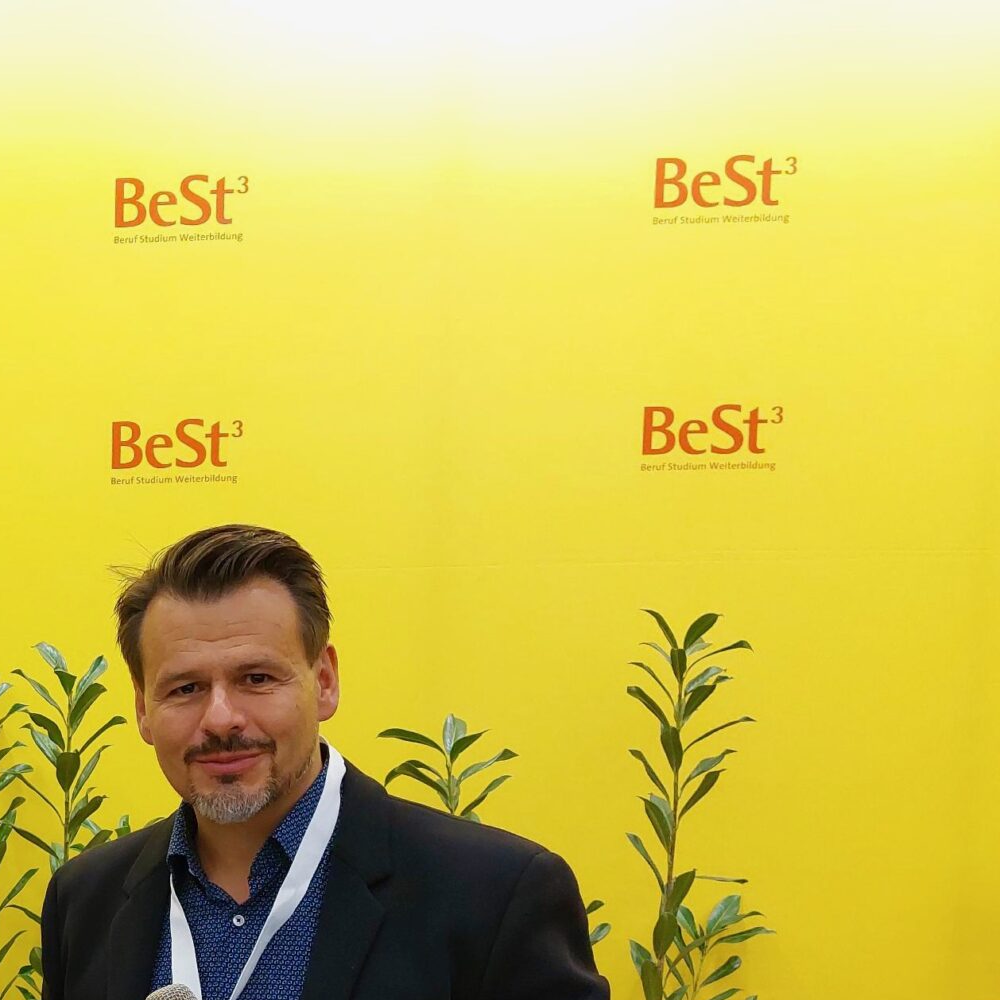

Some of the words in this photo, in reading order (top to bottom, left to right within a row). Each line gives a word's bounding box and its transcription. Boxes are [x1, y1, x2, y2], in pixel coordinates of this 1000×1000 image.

[653, 216, 677, 224] Beruf
[680, 216, 719, 224] Studium
[723, 214, 789, 223] Weiterbildung
[114, 235, 138, 243] Beruf
[140, 234, 176, 243] Studium
[180, 232, 243, 242] Weiterbildung
[641, 463, 665, 471] Beruf
[710, 461, 775, 471] Weiterbildung
[111, 476, 134, 484] Beruf
[136, 475, 172, 484] Studium
[175, 474, 237, 484] Weiterbildung
